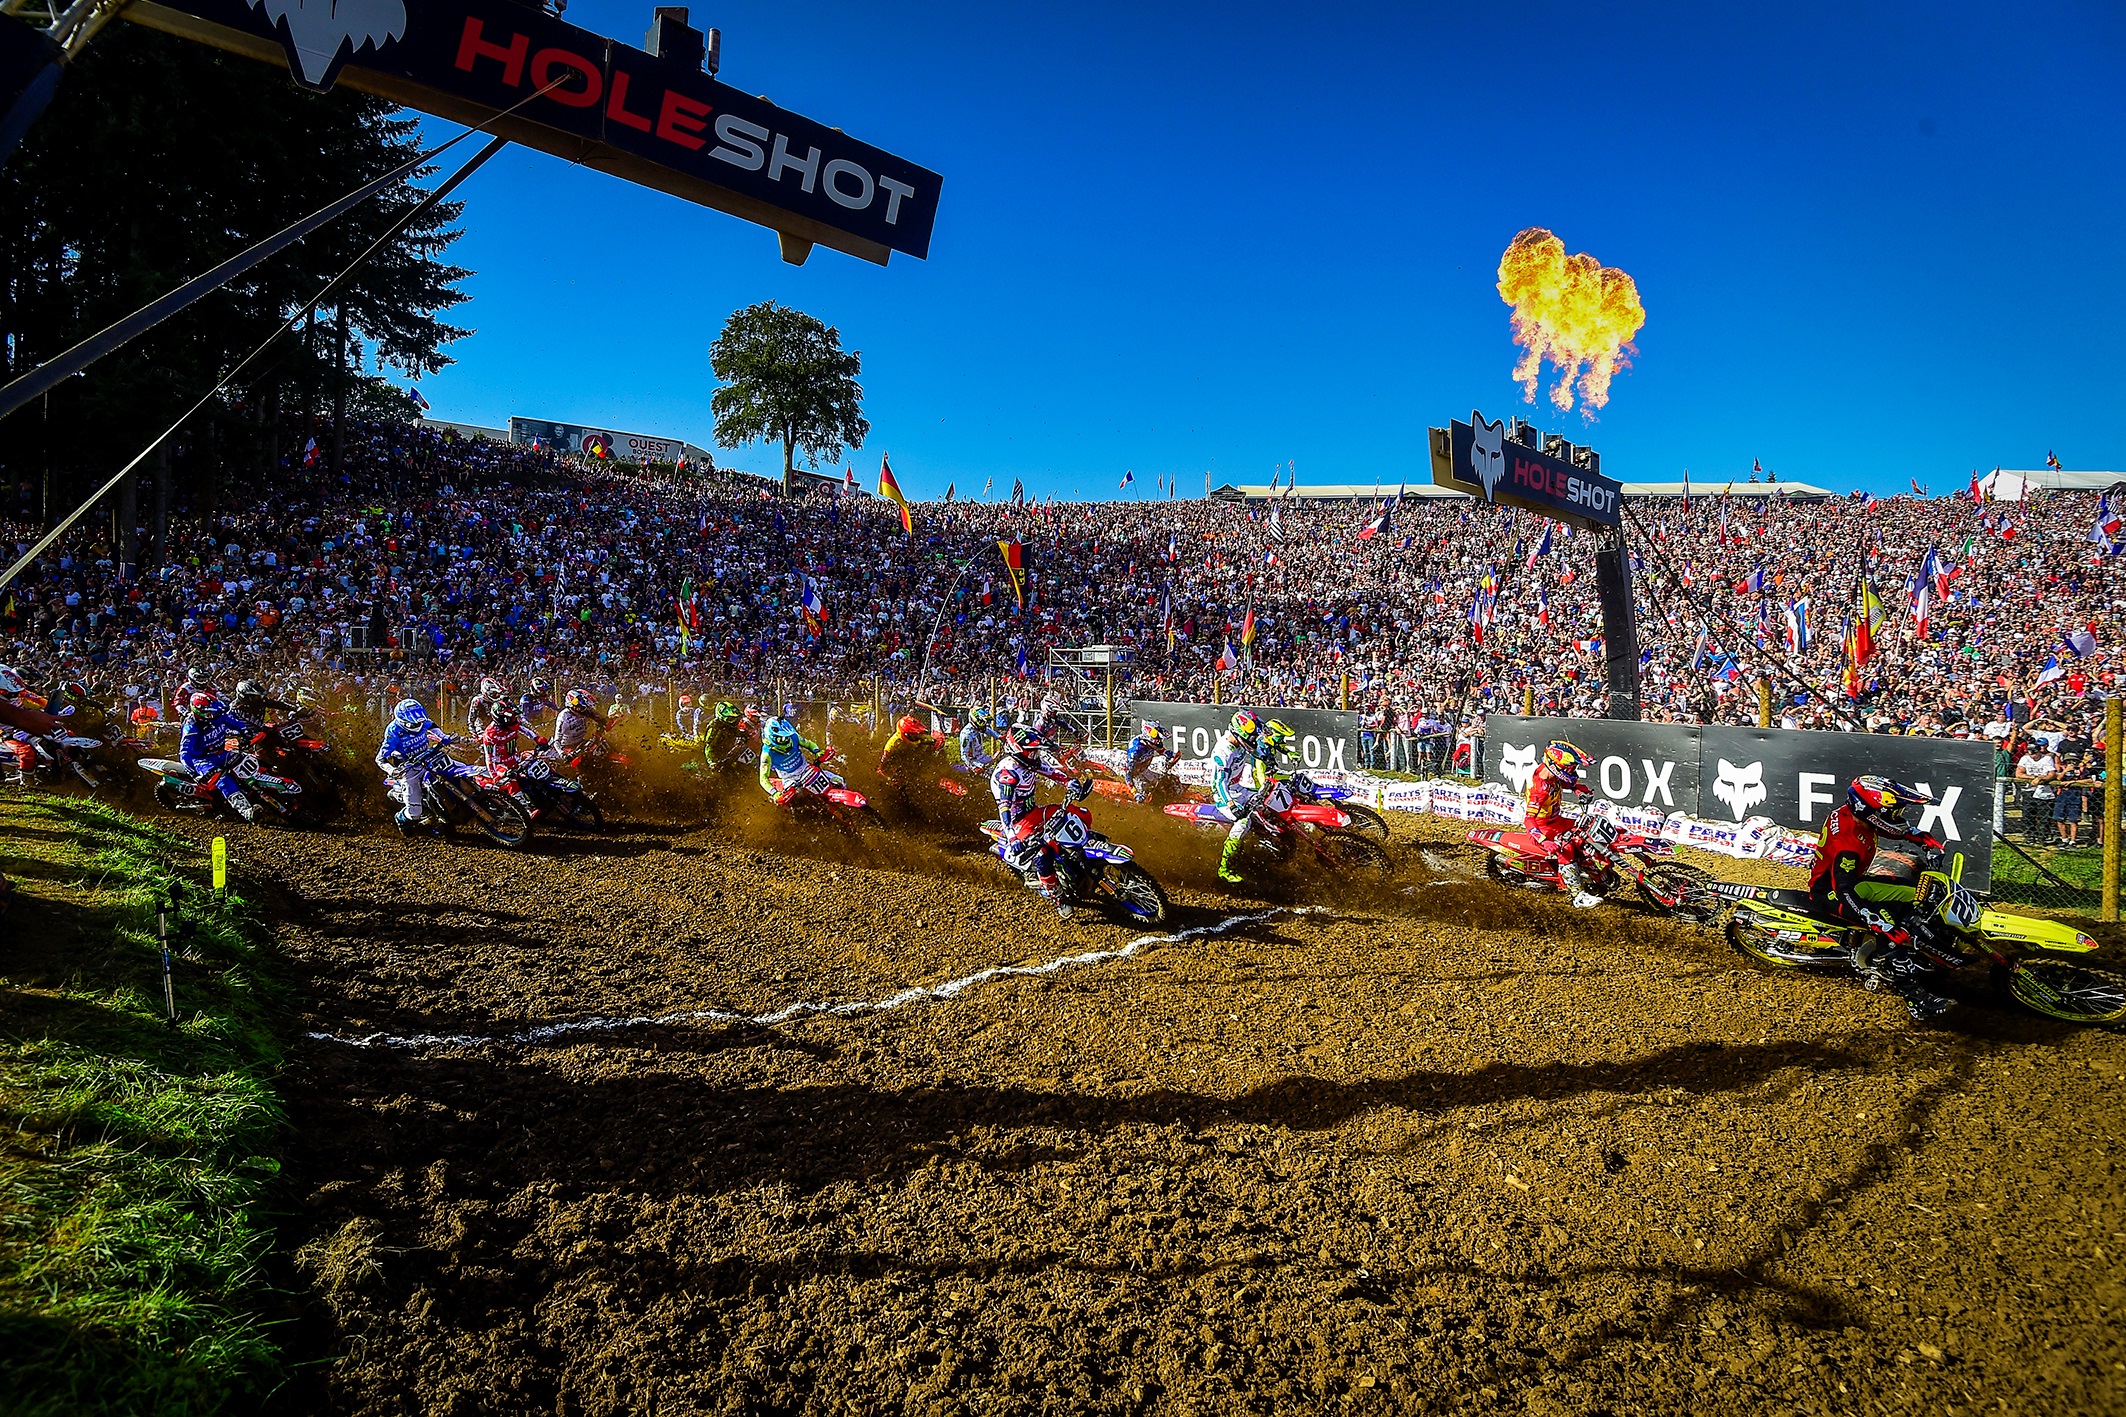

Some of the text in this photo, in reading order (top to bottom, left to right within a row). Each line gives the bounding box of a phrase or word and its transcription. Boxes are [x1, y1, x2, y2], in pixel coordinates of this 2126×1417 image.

[454, 16, 915, 226] HOLESHOT
[628, 438, 670, 453] OUEST
[632, 448, 666, 459] BOSSONS
[1513, 457, 1616, 515] HOLESHOT
[238, 755, 260, 776] 10
[740, 750, 755, 763] 75
[531, 759, 550, 779] 25
[179, 783, 197, 795] 10
[811, 774, 831, 794] 118
[1433, 788, 1461, 800] ARTS
[1433, 804, 1461, 815] ARTS
[1798, 772, 1963, 842] FX
[1064, 820, 1083, 842] 6
[1830, 810, 1840, 836] CZEN
[1689, 825, 1737, 841] PART
[1777, 929, 1802, 943] 22
